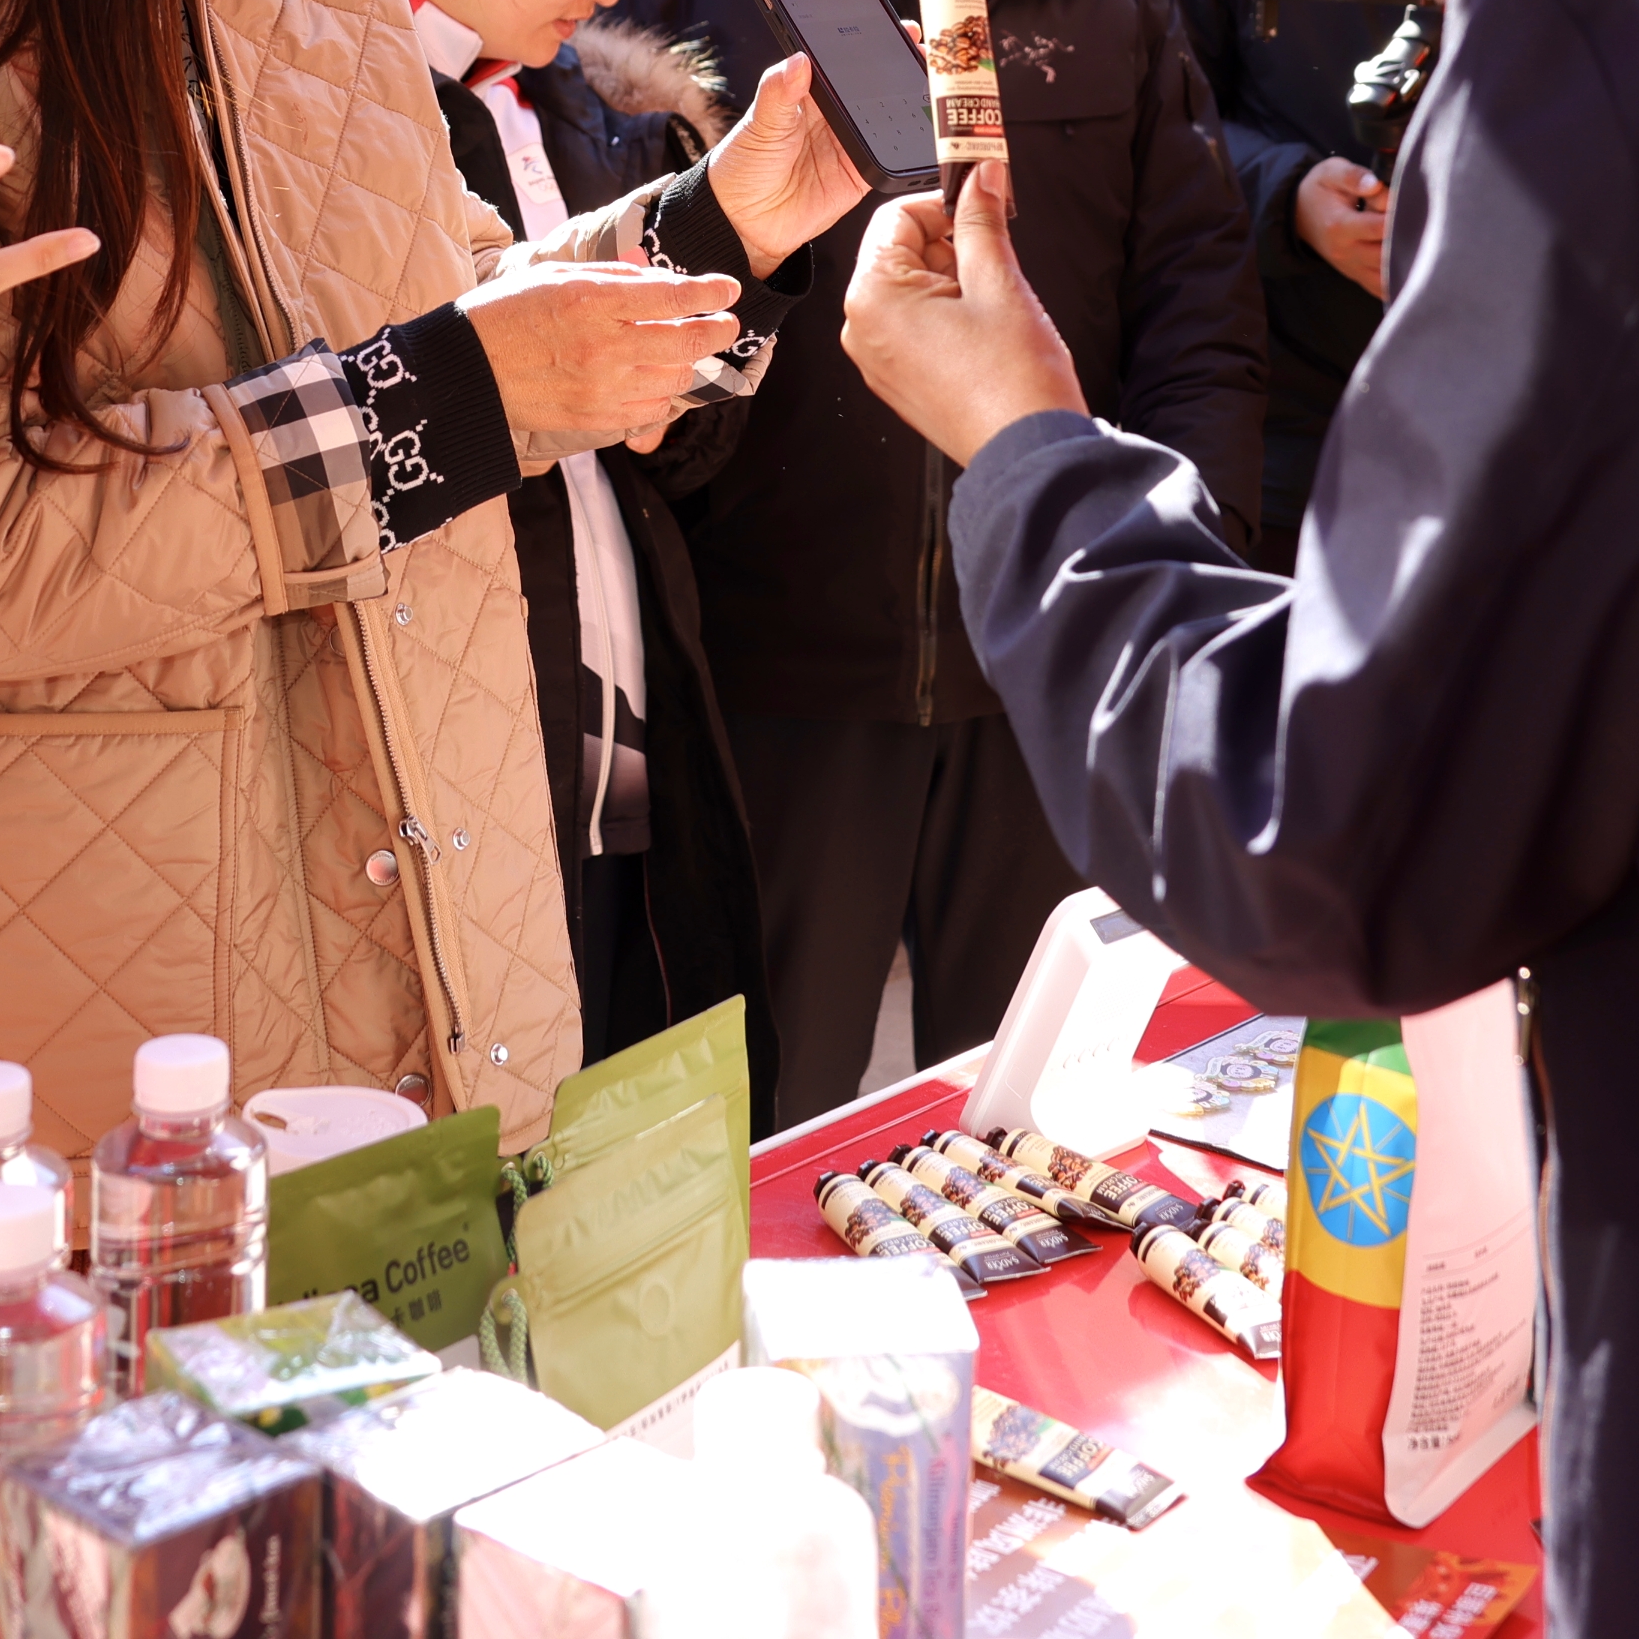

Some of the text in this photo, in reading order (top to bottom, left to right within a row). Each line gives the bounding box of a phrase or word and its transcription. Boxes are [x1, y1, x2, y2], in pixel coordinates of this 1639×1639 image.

[946, 96, 980, 109] CREAM
[946, 108, 1003, 125] COFFEE
[384, 1237, 470, 1294] Coffee
